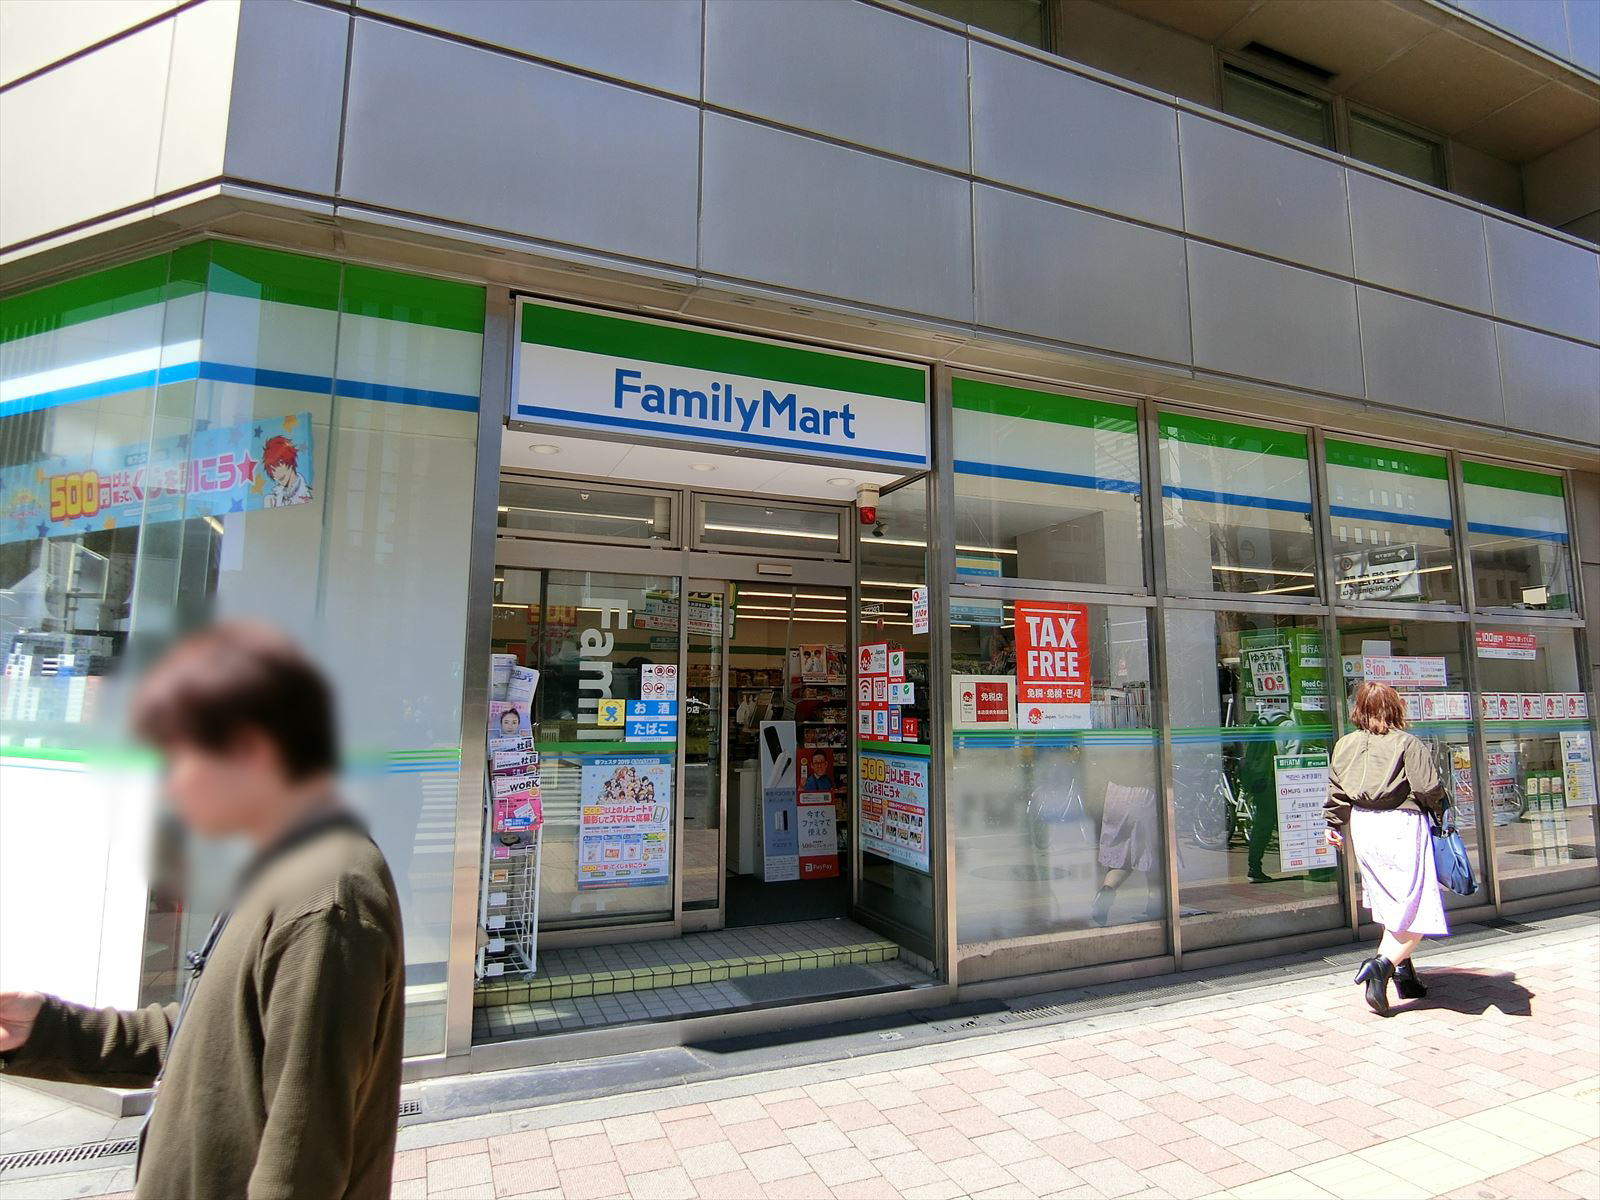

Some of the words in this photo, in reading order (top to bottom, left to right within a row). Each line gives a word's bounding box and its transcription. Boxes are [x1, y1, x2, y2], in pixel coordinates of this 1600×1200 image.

[613, 367, 856, 439] FamilyMart
[1025, 616, 1078, 648] TAX
[1027, 650, 1080, 677] FREE
[1257, 661, 1281, 673] ATM
[980, 691, 1003, 701] 免税店
[634, 722, 669, 735] たばこ
[516, 740, 532, 751] 社員
[521, 755, 537, 765] 社員
[509, 780, 540, 791] WORK
[802, 819, 831, 828] ファミマで
[808, 828, 828, 837] 使える
